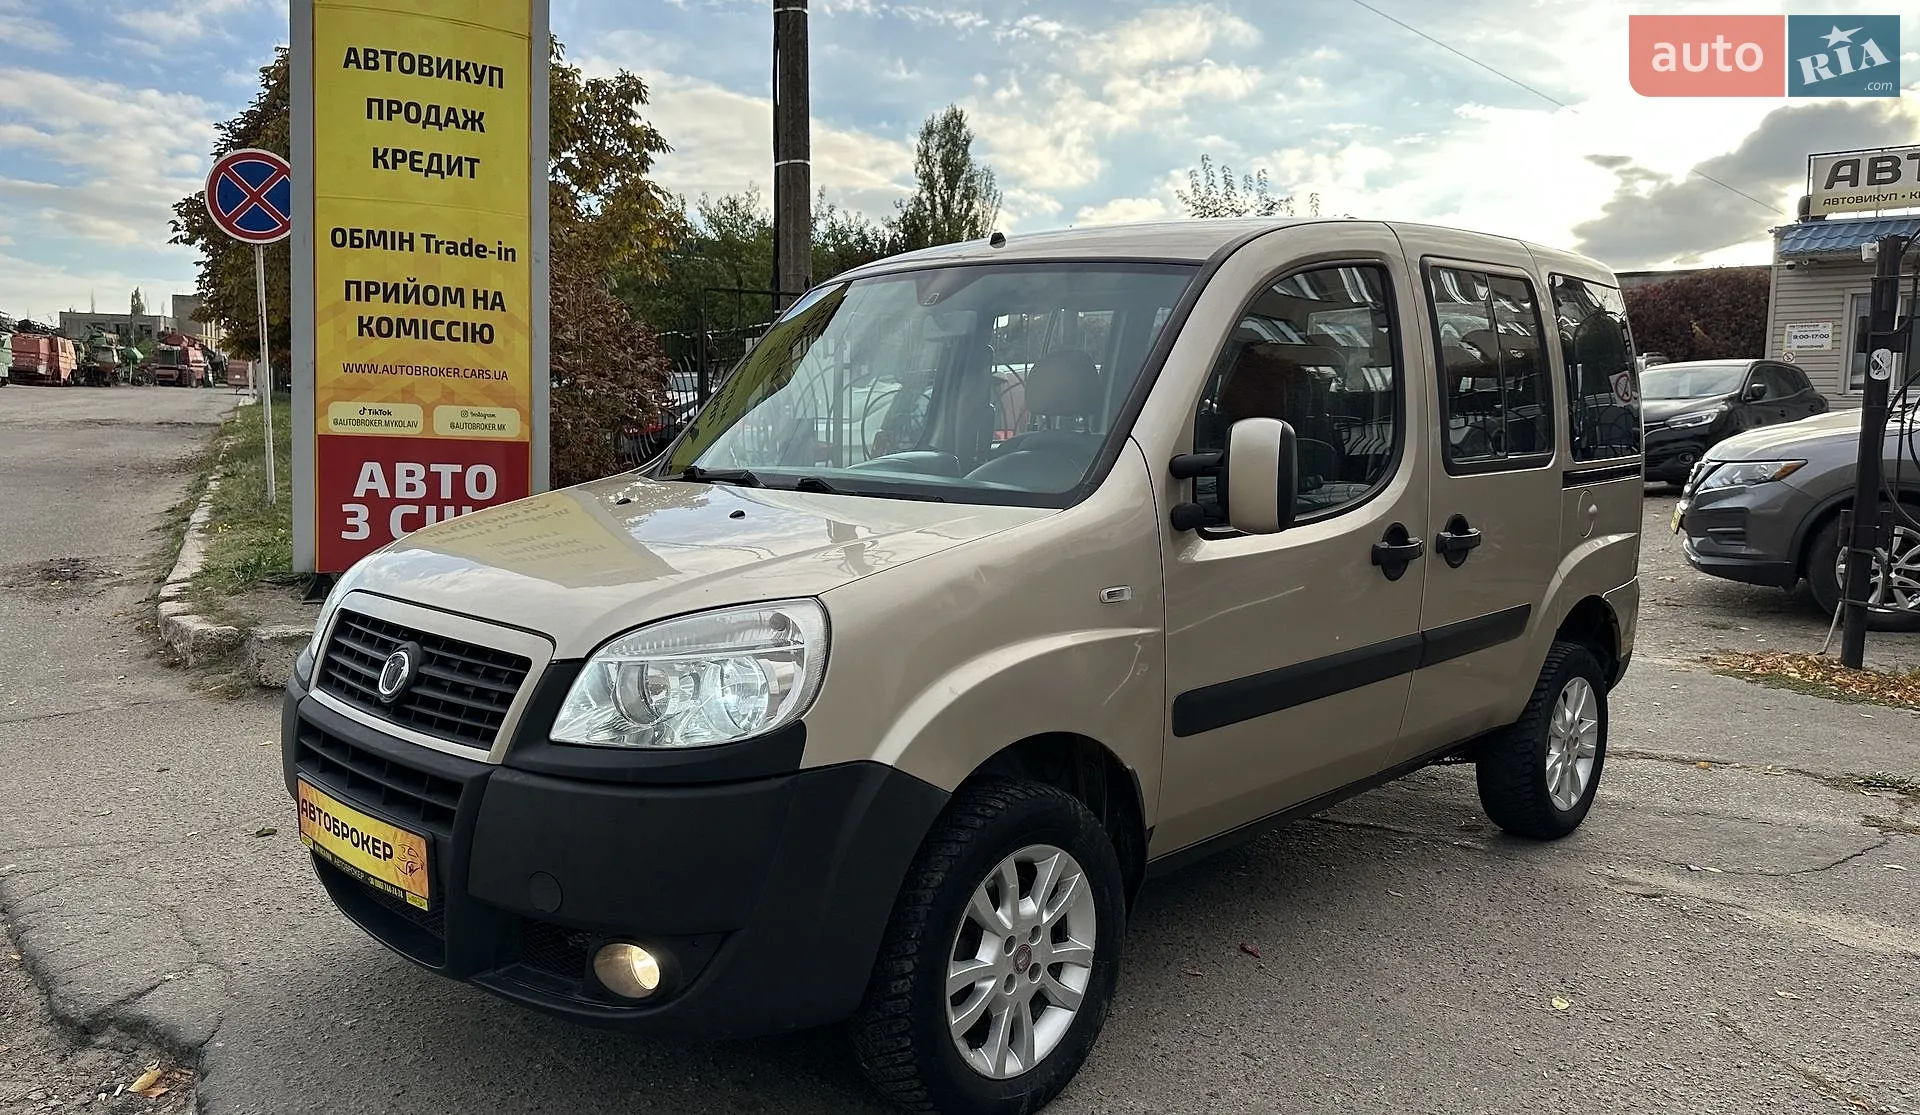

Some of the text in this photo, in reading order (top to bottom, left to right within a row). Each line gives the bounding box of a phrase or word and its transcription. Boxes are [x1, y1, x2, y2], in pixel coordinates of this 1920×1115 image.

[342, 46, 504, 89] АВТОВИКУП
[366, 97, 486, 133] ПРОДАЖ
[372, 146, 481, 179] КРЕДИТ
[1822, 192, 1898, 206] АВТОВИКУП
[330, 226, 517, 263] ОБМІН Trade-in
[344, 277, 507, 312] ПРИЙОМ НА
[357, 315, 495, 345] КОМІССІЮ
[342, 362, 509, 381] WWW.AUTOBROKER.CARS.UA
[332, 418, 419, 429] @AUTOBROKER.MYKOLAIV
[367, 408, 393, 417] TikTok
[449, 421, 507, 431] @AUTOBROKER.MK
[353, 461, 498, 501] АВТО
[301, 797, 394, 862] АВТОБРОКЕР
